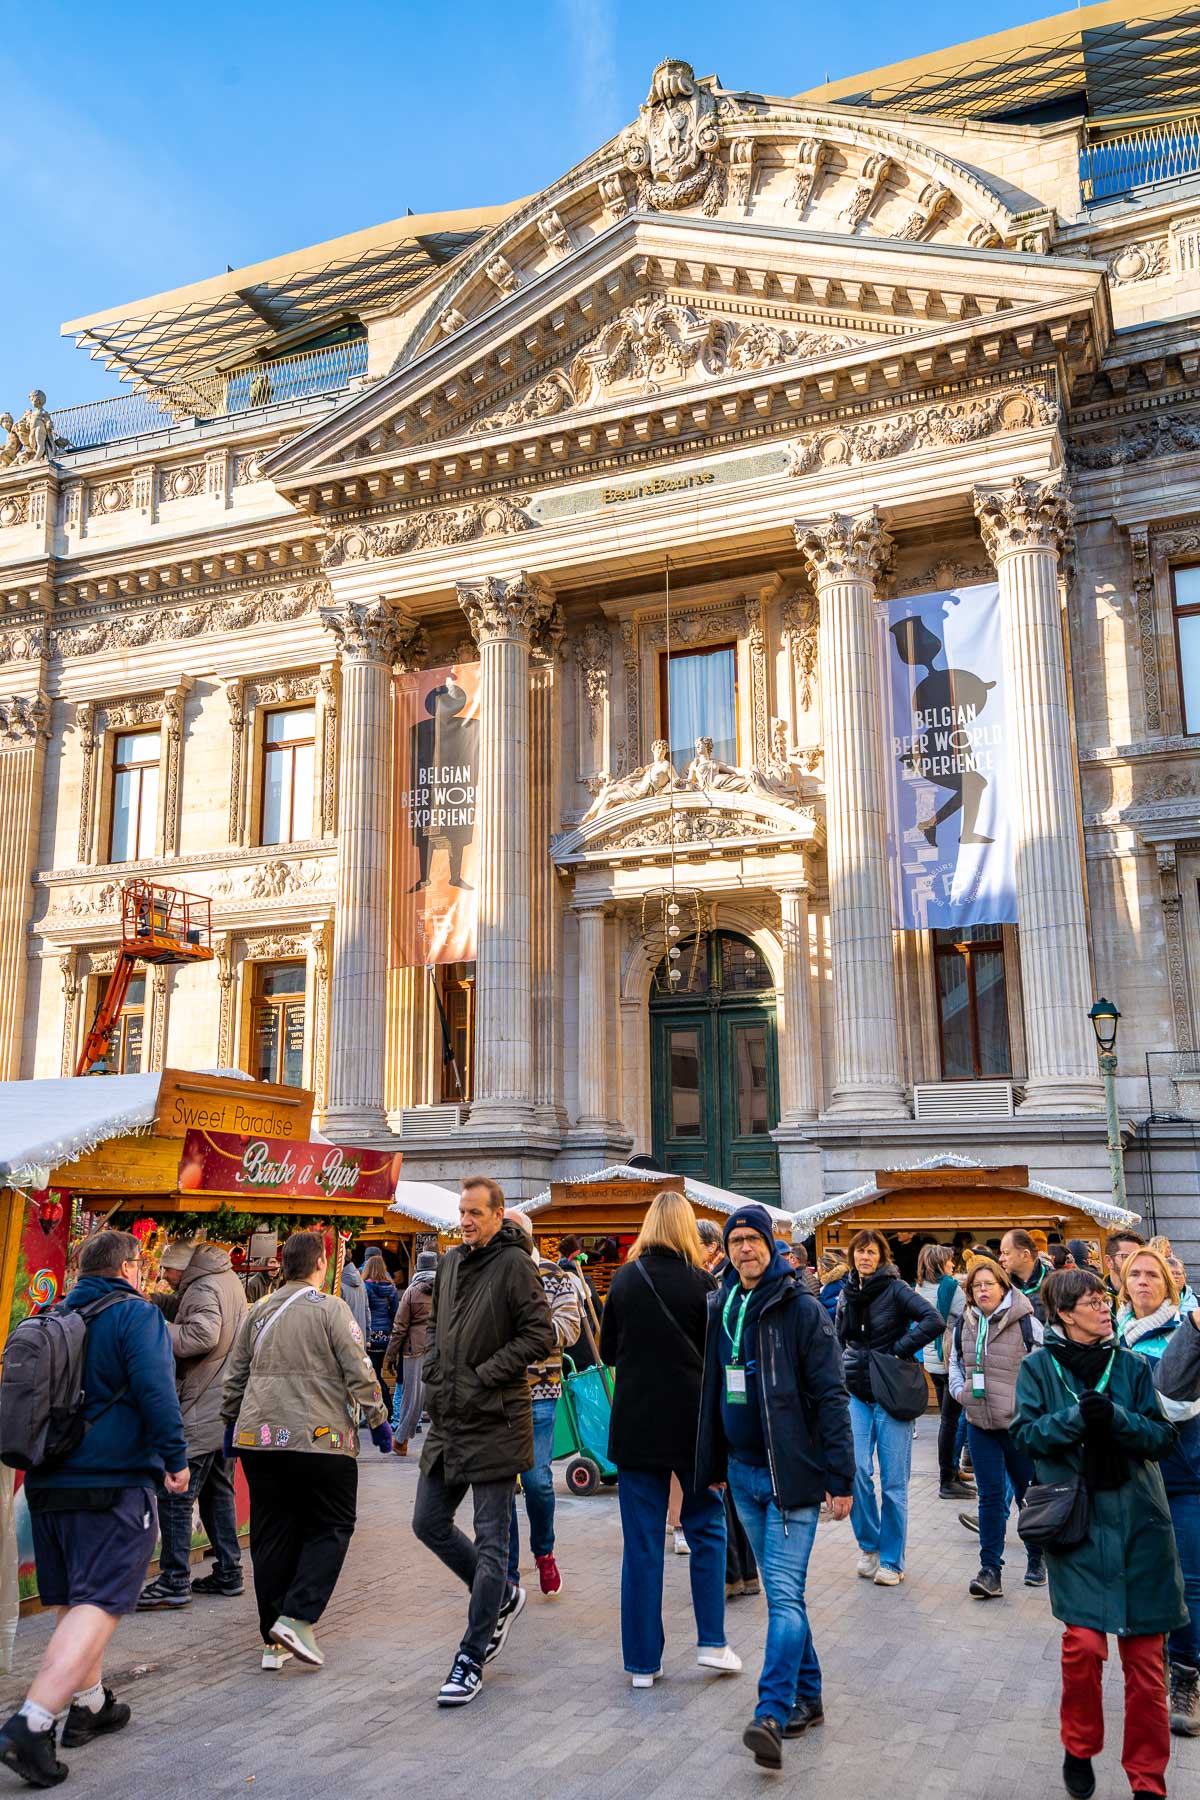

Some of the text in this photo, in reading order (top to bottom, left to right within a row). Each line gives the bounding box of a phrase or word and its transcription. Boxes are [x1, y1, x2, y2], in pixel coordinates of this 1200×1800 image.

[892, 724, 1003, 758] BEER WORLD
[401, 788, 430, 809] BEER
[172, 1097, 293, 1137] Sweet Paradise
[235, 1141, 361, 1197] Barbe à Papà
[591, 1187, 608, 1199] und
